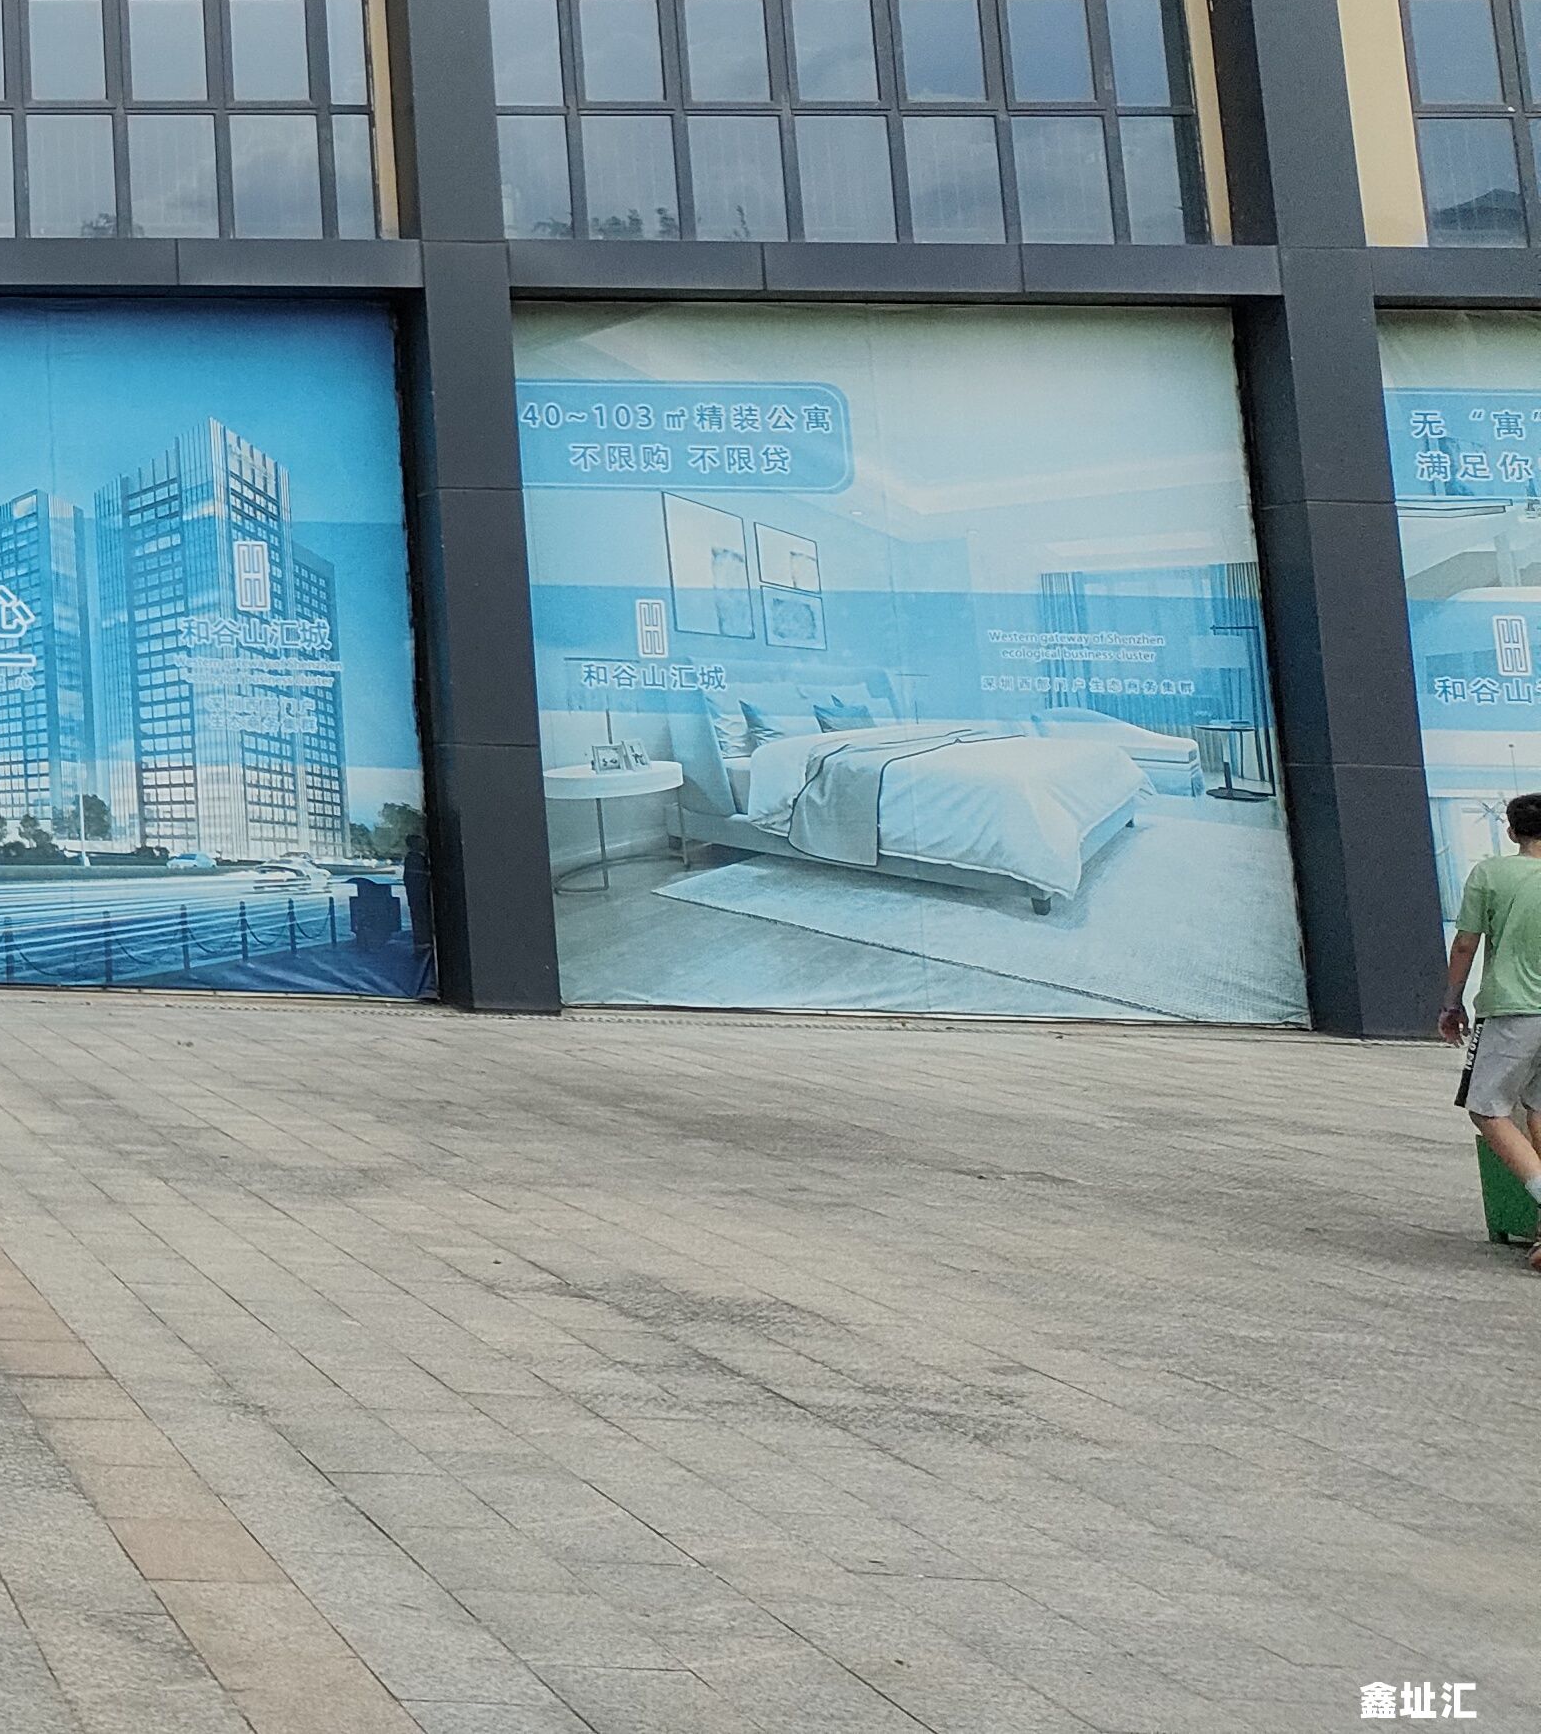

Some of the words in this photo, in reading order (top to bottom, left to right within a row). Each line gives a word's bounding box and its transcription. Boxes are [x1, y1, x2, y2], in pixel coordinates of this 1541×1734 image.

[570, 444, 670, 472] 不限购
[689, 446, 790, 473] 不限贷
[181, 619, 332, 649] 和谷山汇城
[988, 631, 1037, 642] Western
[1040, 632, 1089, 645] gateway
[1092, 632, 1105, 643] of
[1107, 633, 1164, 645] Shenzhen
[1002, 648, 1061, 661] ecological
[1063, 649, 1114, 660] business
[1116, 650, 1156, 661] cluster
[583, 663, 727, 690] 和谷山汇城
[1435, 677, 1541, 704] 和谷山
